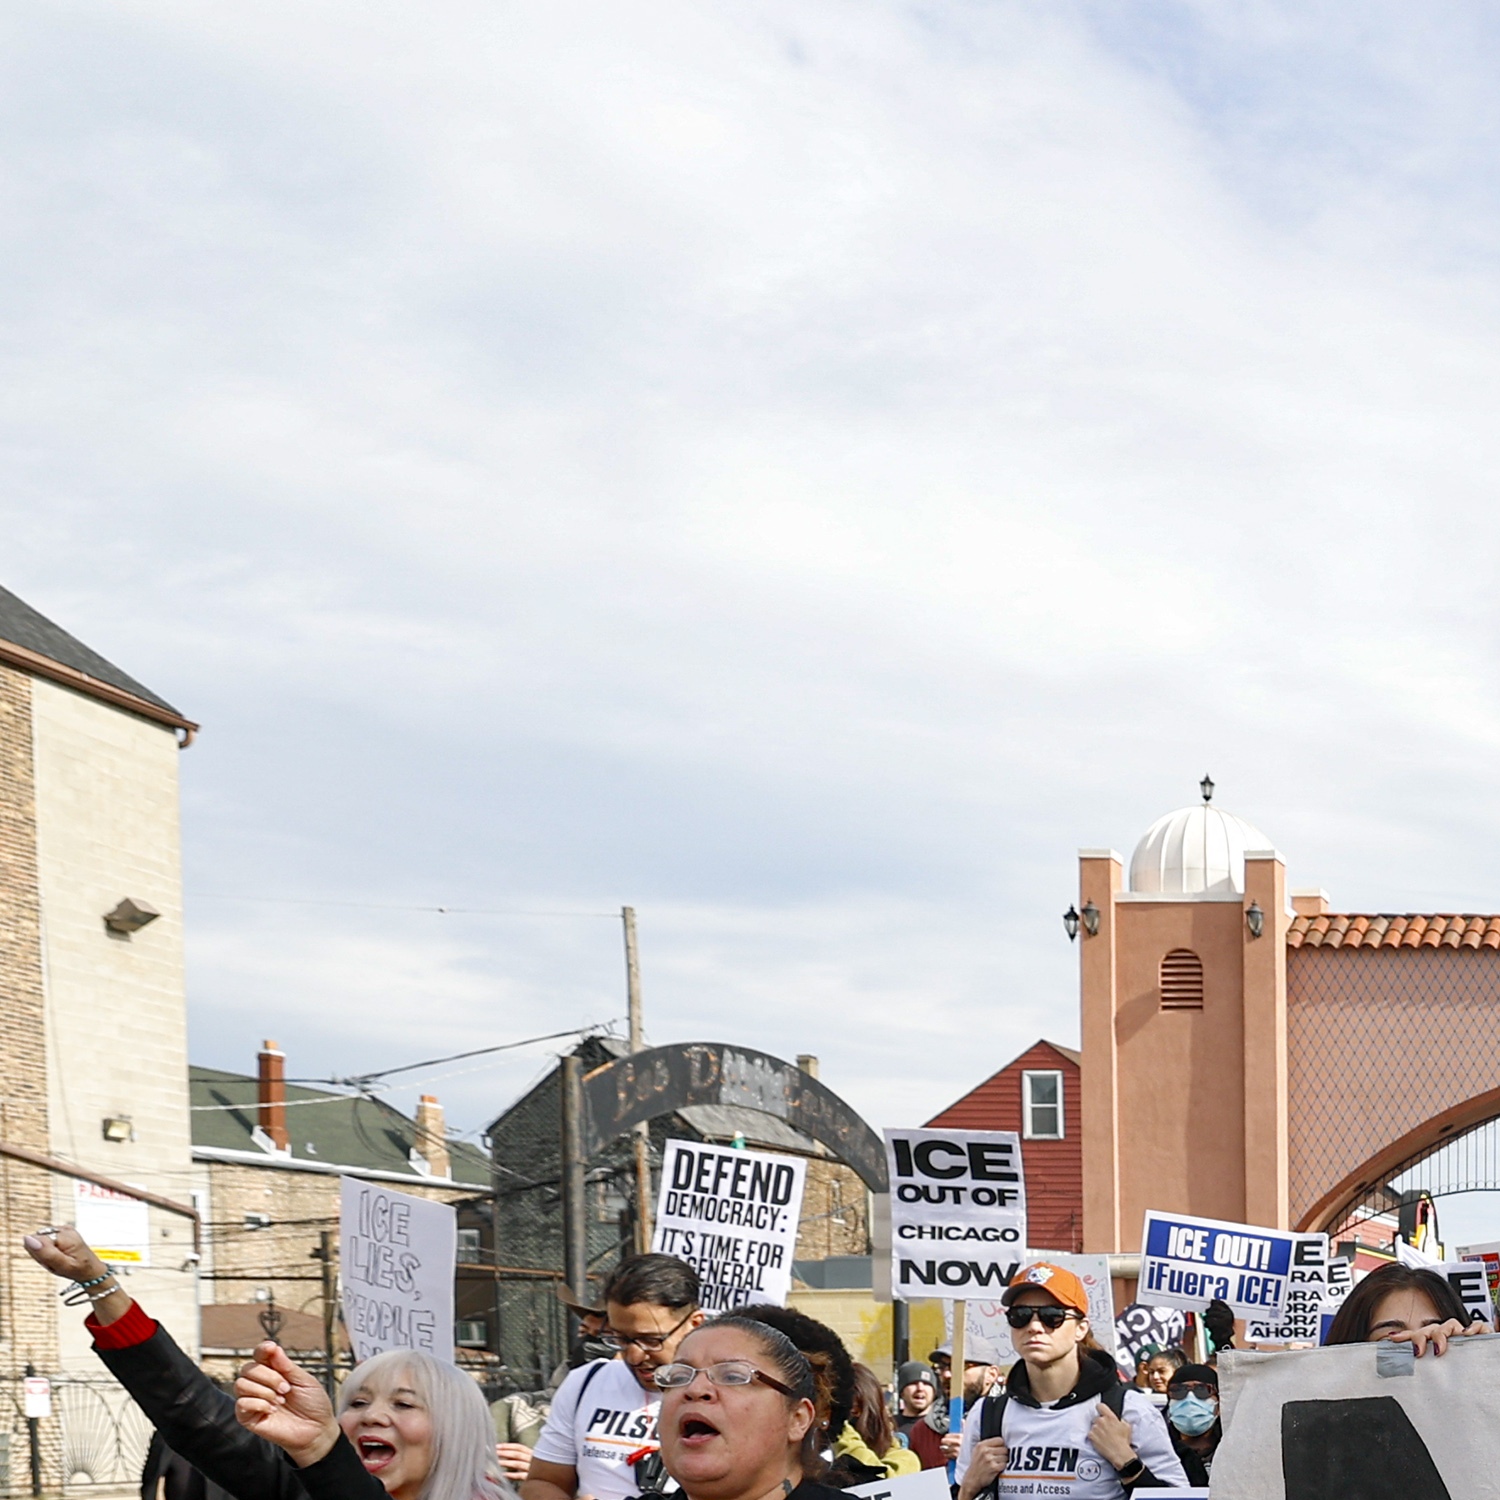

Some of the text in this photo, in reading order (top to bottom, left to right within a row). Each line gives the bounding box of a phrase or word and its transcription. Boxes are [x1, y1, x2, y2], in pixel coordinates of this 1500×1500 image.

[892, 1138, 1019, 1182] ICE
[672, 1148, 795, 1206] DEFEND
[897, 1183, 1018, 1207] OUT OF
[359, 1189, 411, 1248] ICE
[665, 1191, 788, 1233] DEMOCRACY:
[660, 1227, 784, 1269] IT'S TIME FOR
[898, 1224, 1019, 1242] CHICAGO
[1167, 1225, 1209, 1262] ICE
[1213, 1233, 1272, 1270] OUT!
[350, 1235, 423, 1301] LIES,
[899, 1259, 1021, 1287] NOW
[699, 1285, 749, 1311] RIKE!
[1236, 1275, 1282, 1307] ICE!
[1250, 1327, 1317, 1338] AHORA
[1006, 1446, 1079, 1473] ILSEN
[998, 1482, 1071, 1495] efense and Access
